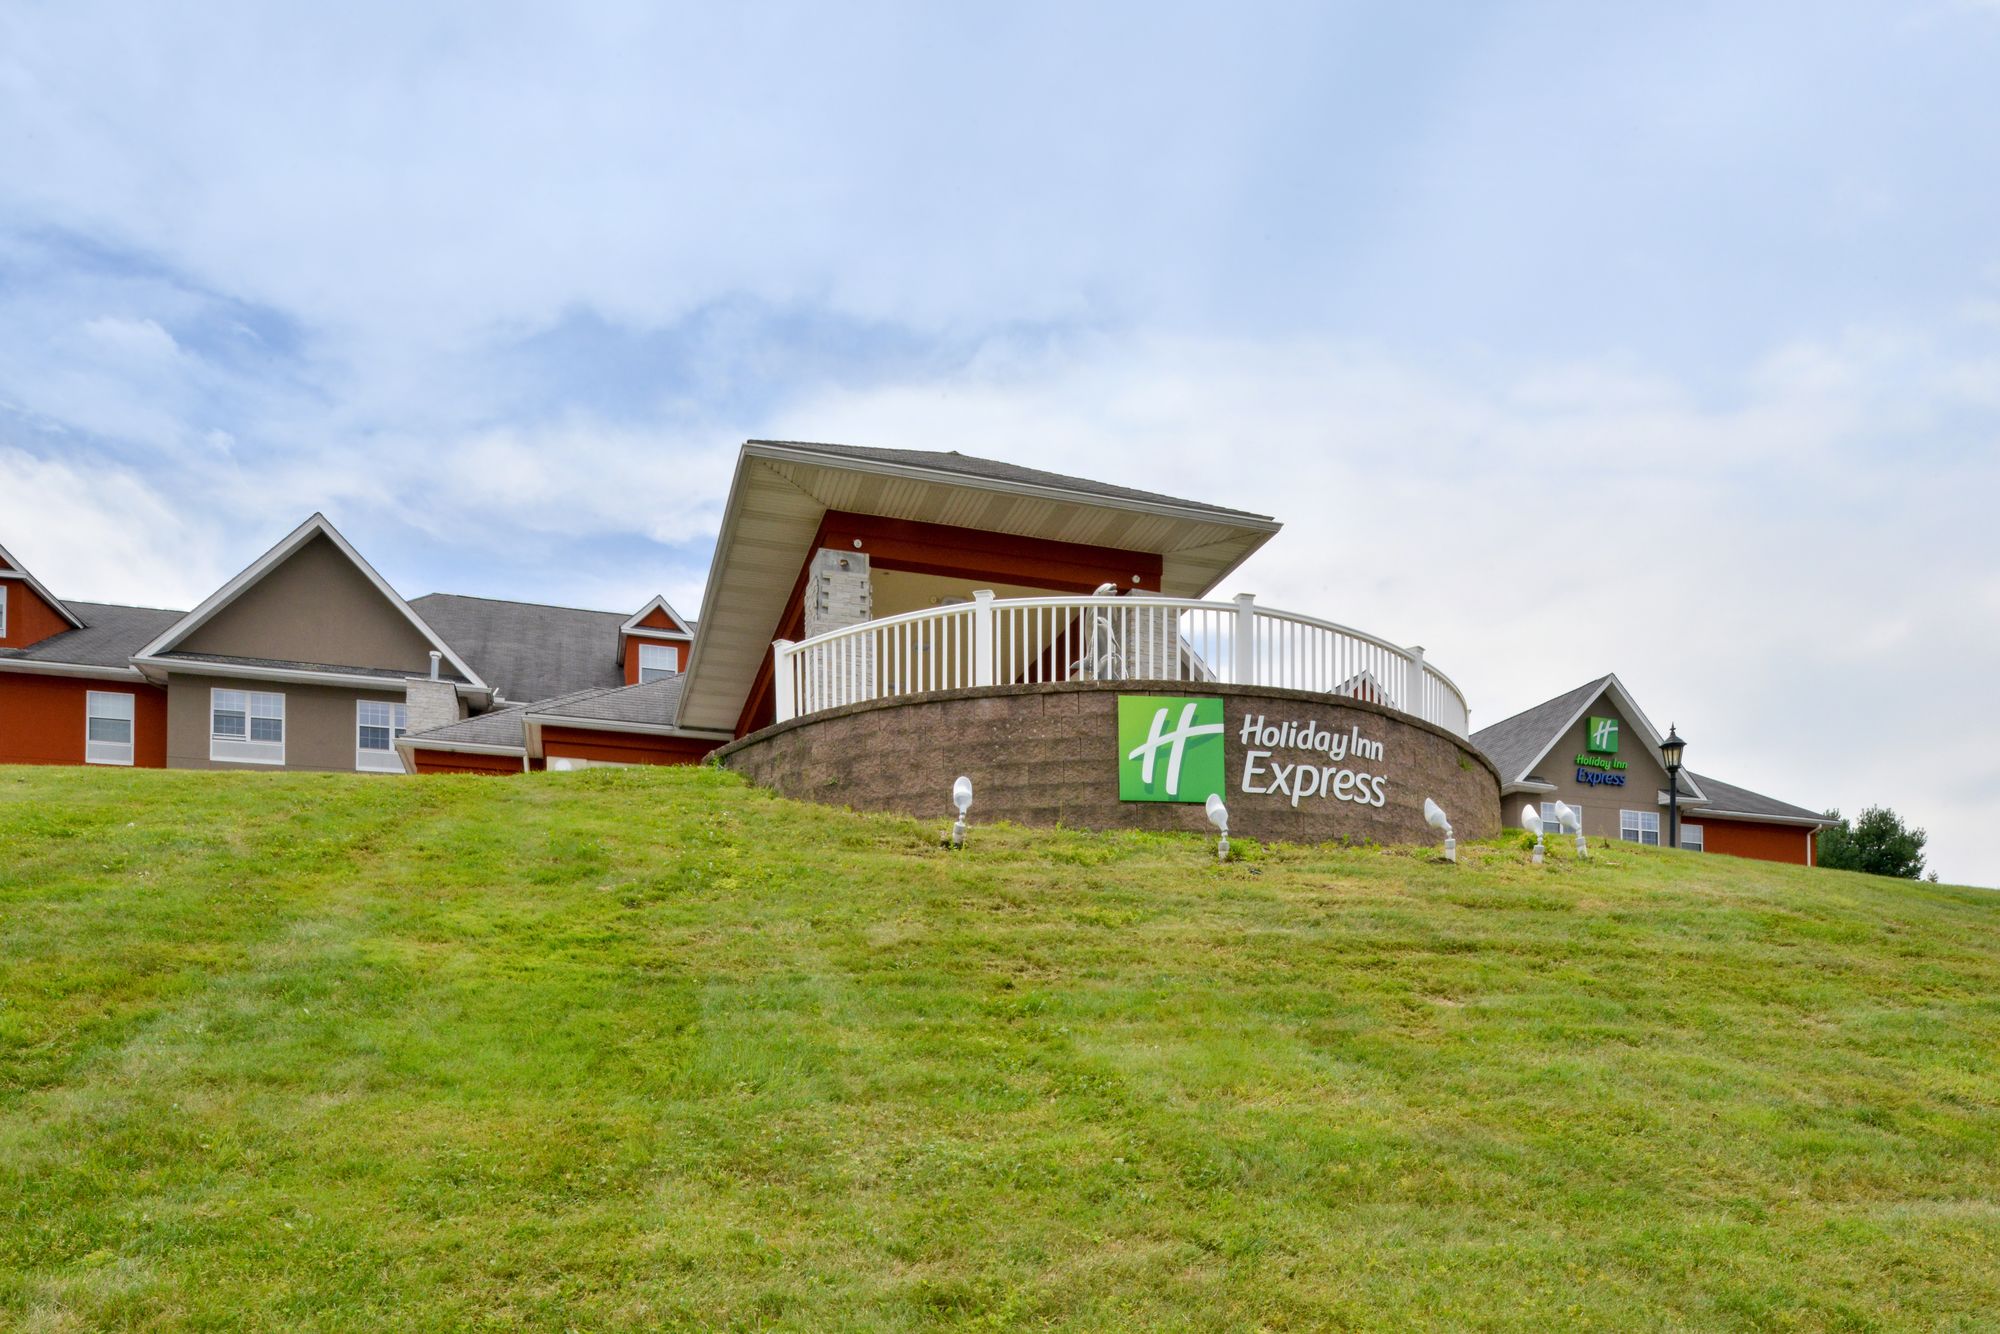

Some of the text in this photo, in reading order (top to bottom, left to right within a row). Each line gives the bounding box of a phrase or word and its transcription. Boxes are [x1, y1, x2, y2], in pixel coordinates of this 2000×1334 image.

[1239, 714, 1384, 762] Holiday Inn
[1576, 754, 1628, 770] Holiday Inn
[1577, 767, 1625, 786] Express
[1241, 750, 1387, 808] Express
